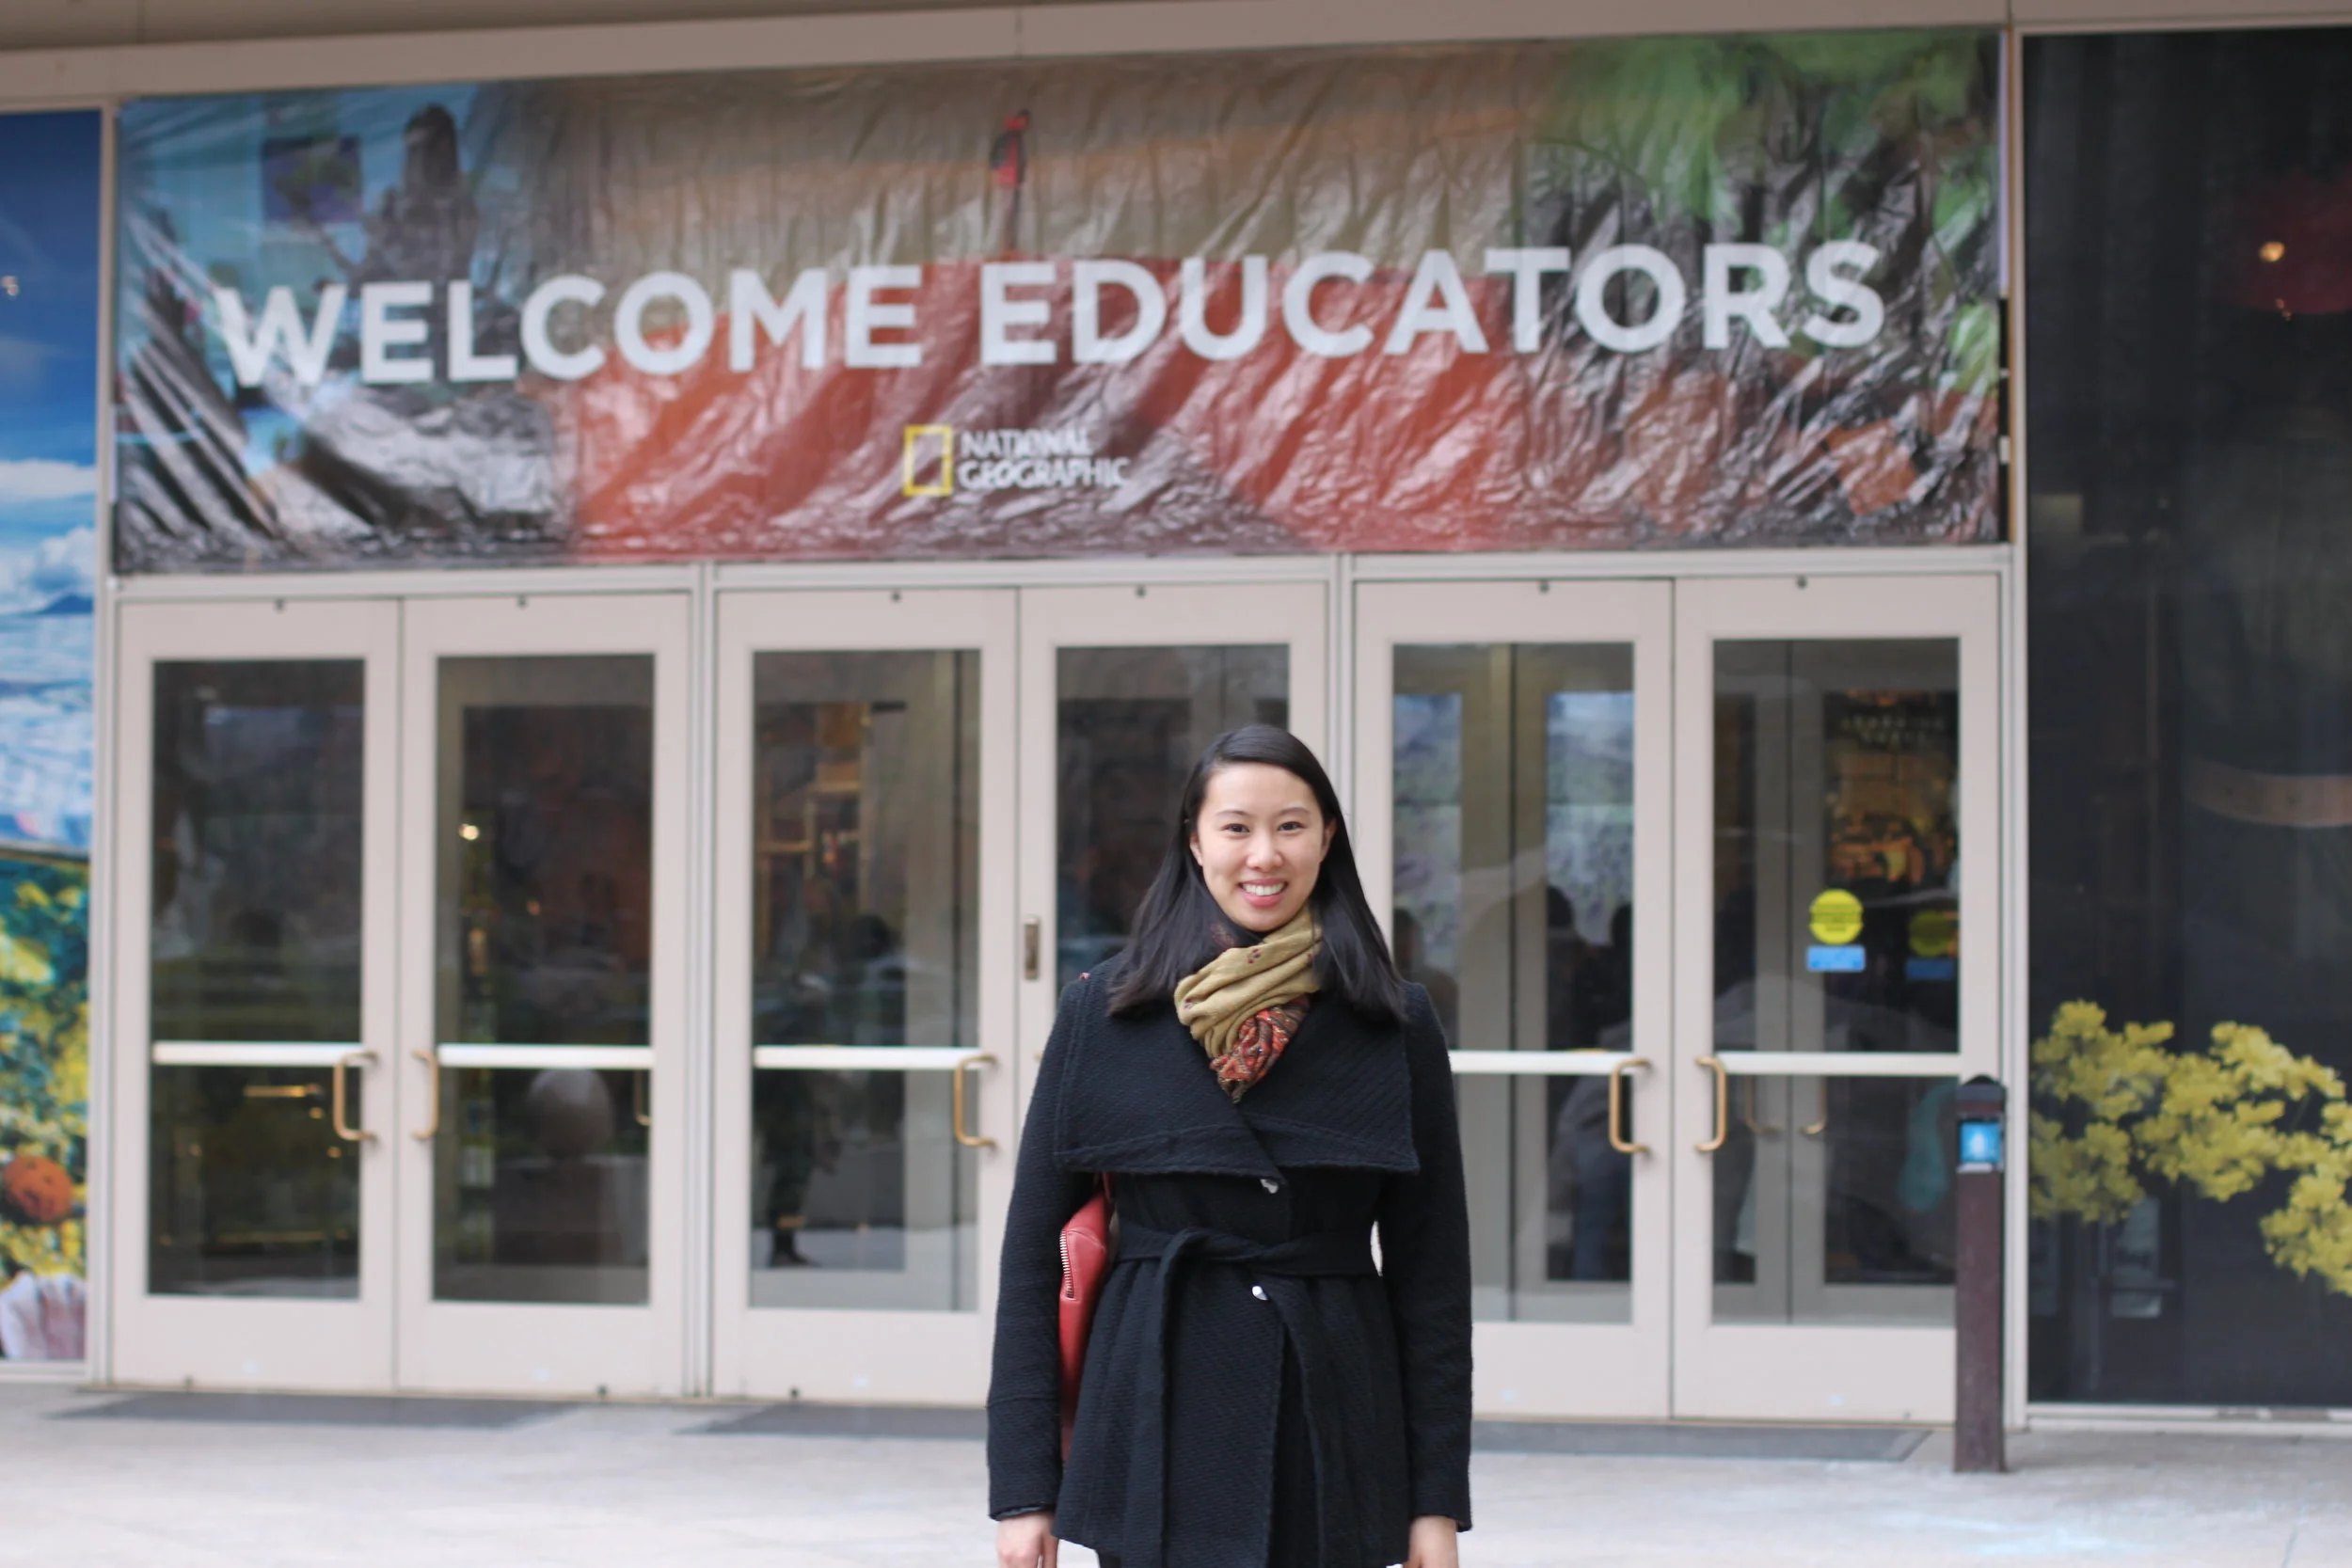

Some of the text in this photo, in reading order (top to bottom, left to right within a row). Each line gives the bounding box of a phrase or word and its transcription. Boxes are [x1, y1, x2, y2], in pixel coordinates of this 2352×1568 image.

[215, 239, 1884, 386] WELCOME EDUCATORS
[961, 429, 1092, 457] NATIONAL
[958, 457, 1131, 489] GEOGRAPHIC
